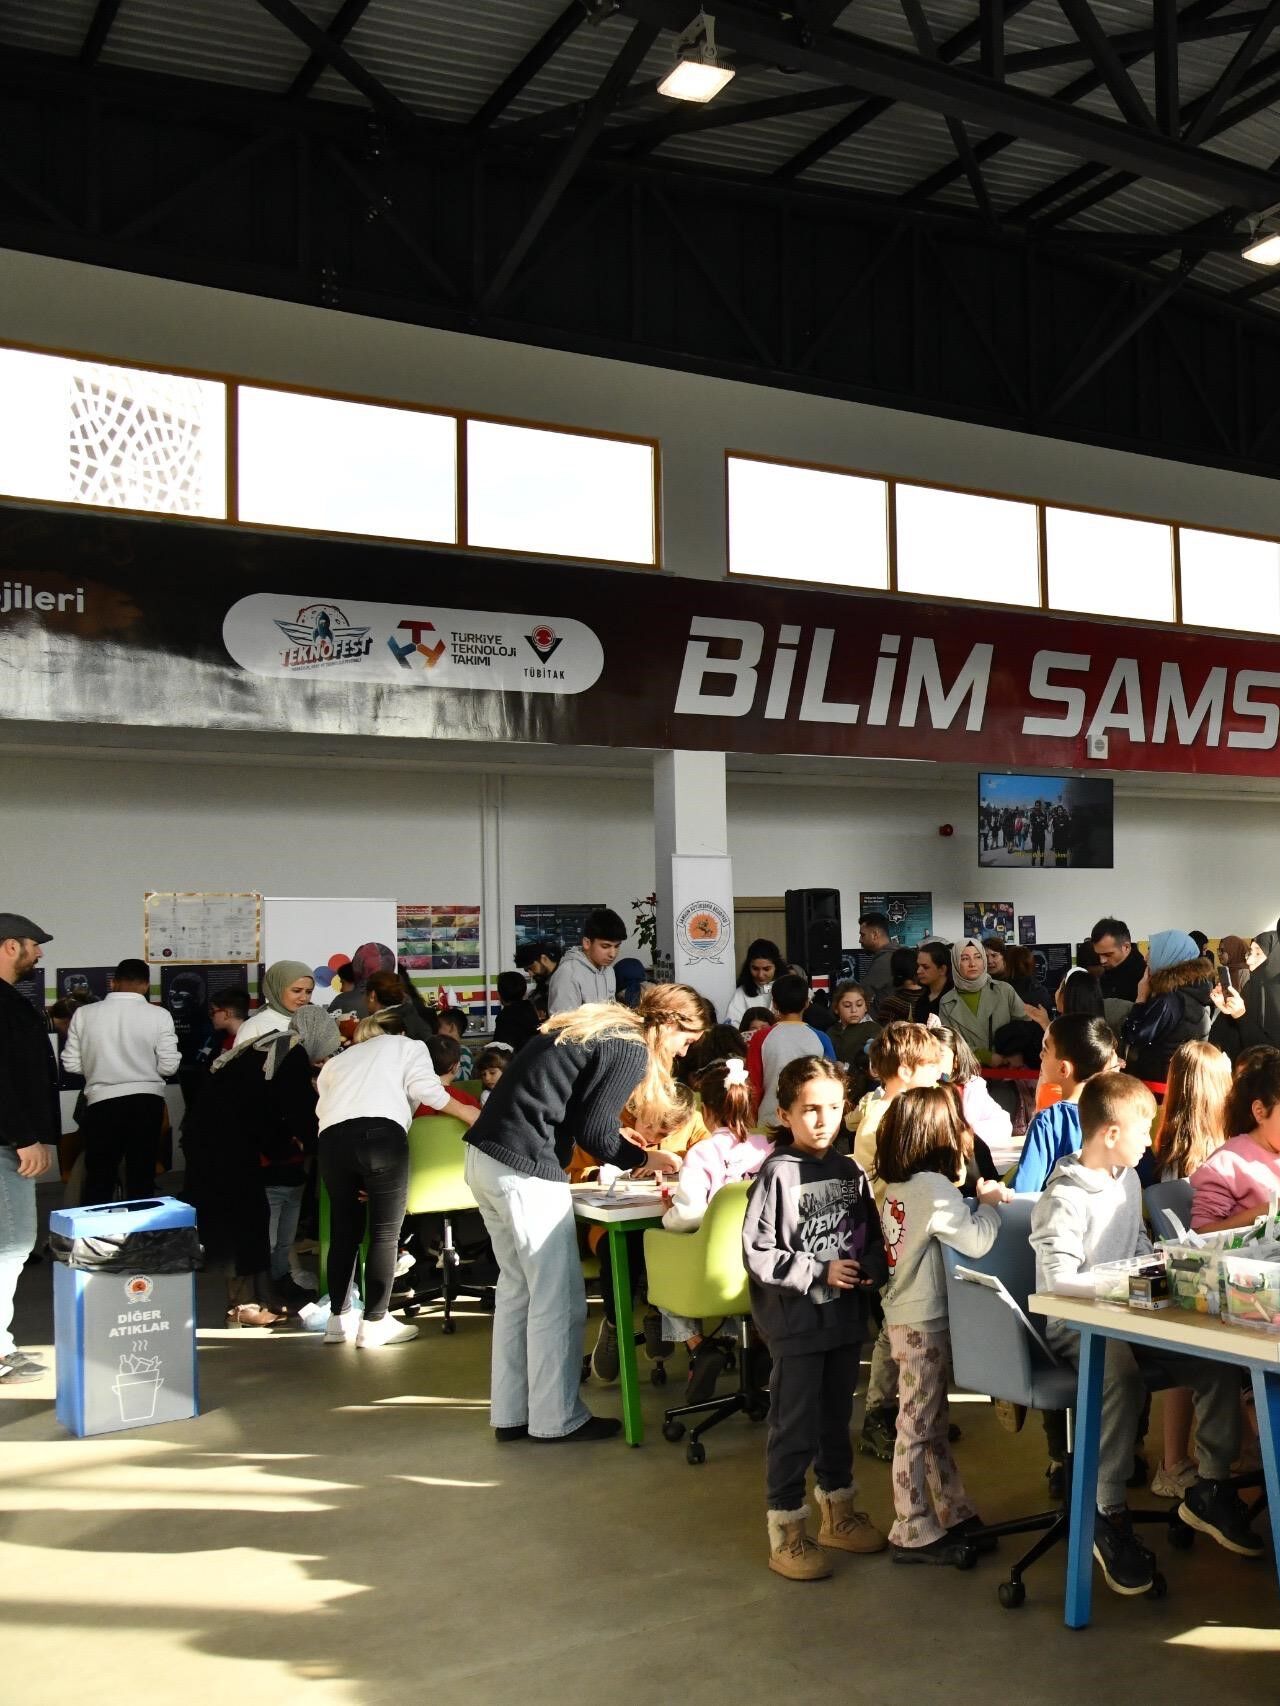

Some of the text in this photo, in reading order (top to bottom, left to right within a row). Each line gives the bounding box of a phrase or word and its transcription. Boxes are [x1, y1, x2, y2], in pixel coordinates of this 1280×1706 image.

[0, 581, 84, 613] jileri
[279, 637, 373, 667] TEKNOFEST
[450, 654, 491, 666] TAKIMI
[800, 1208, 848, 1240] NEW
[802, 1229, 853, 1254] YORK
[108, 1321, 170, 1338] ATIKLAR
